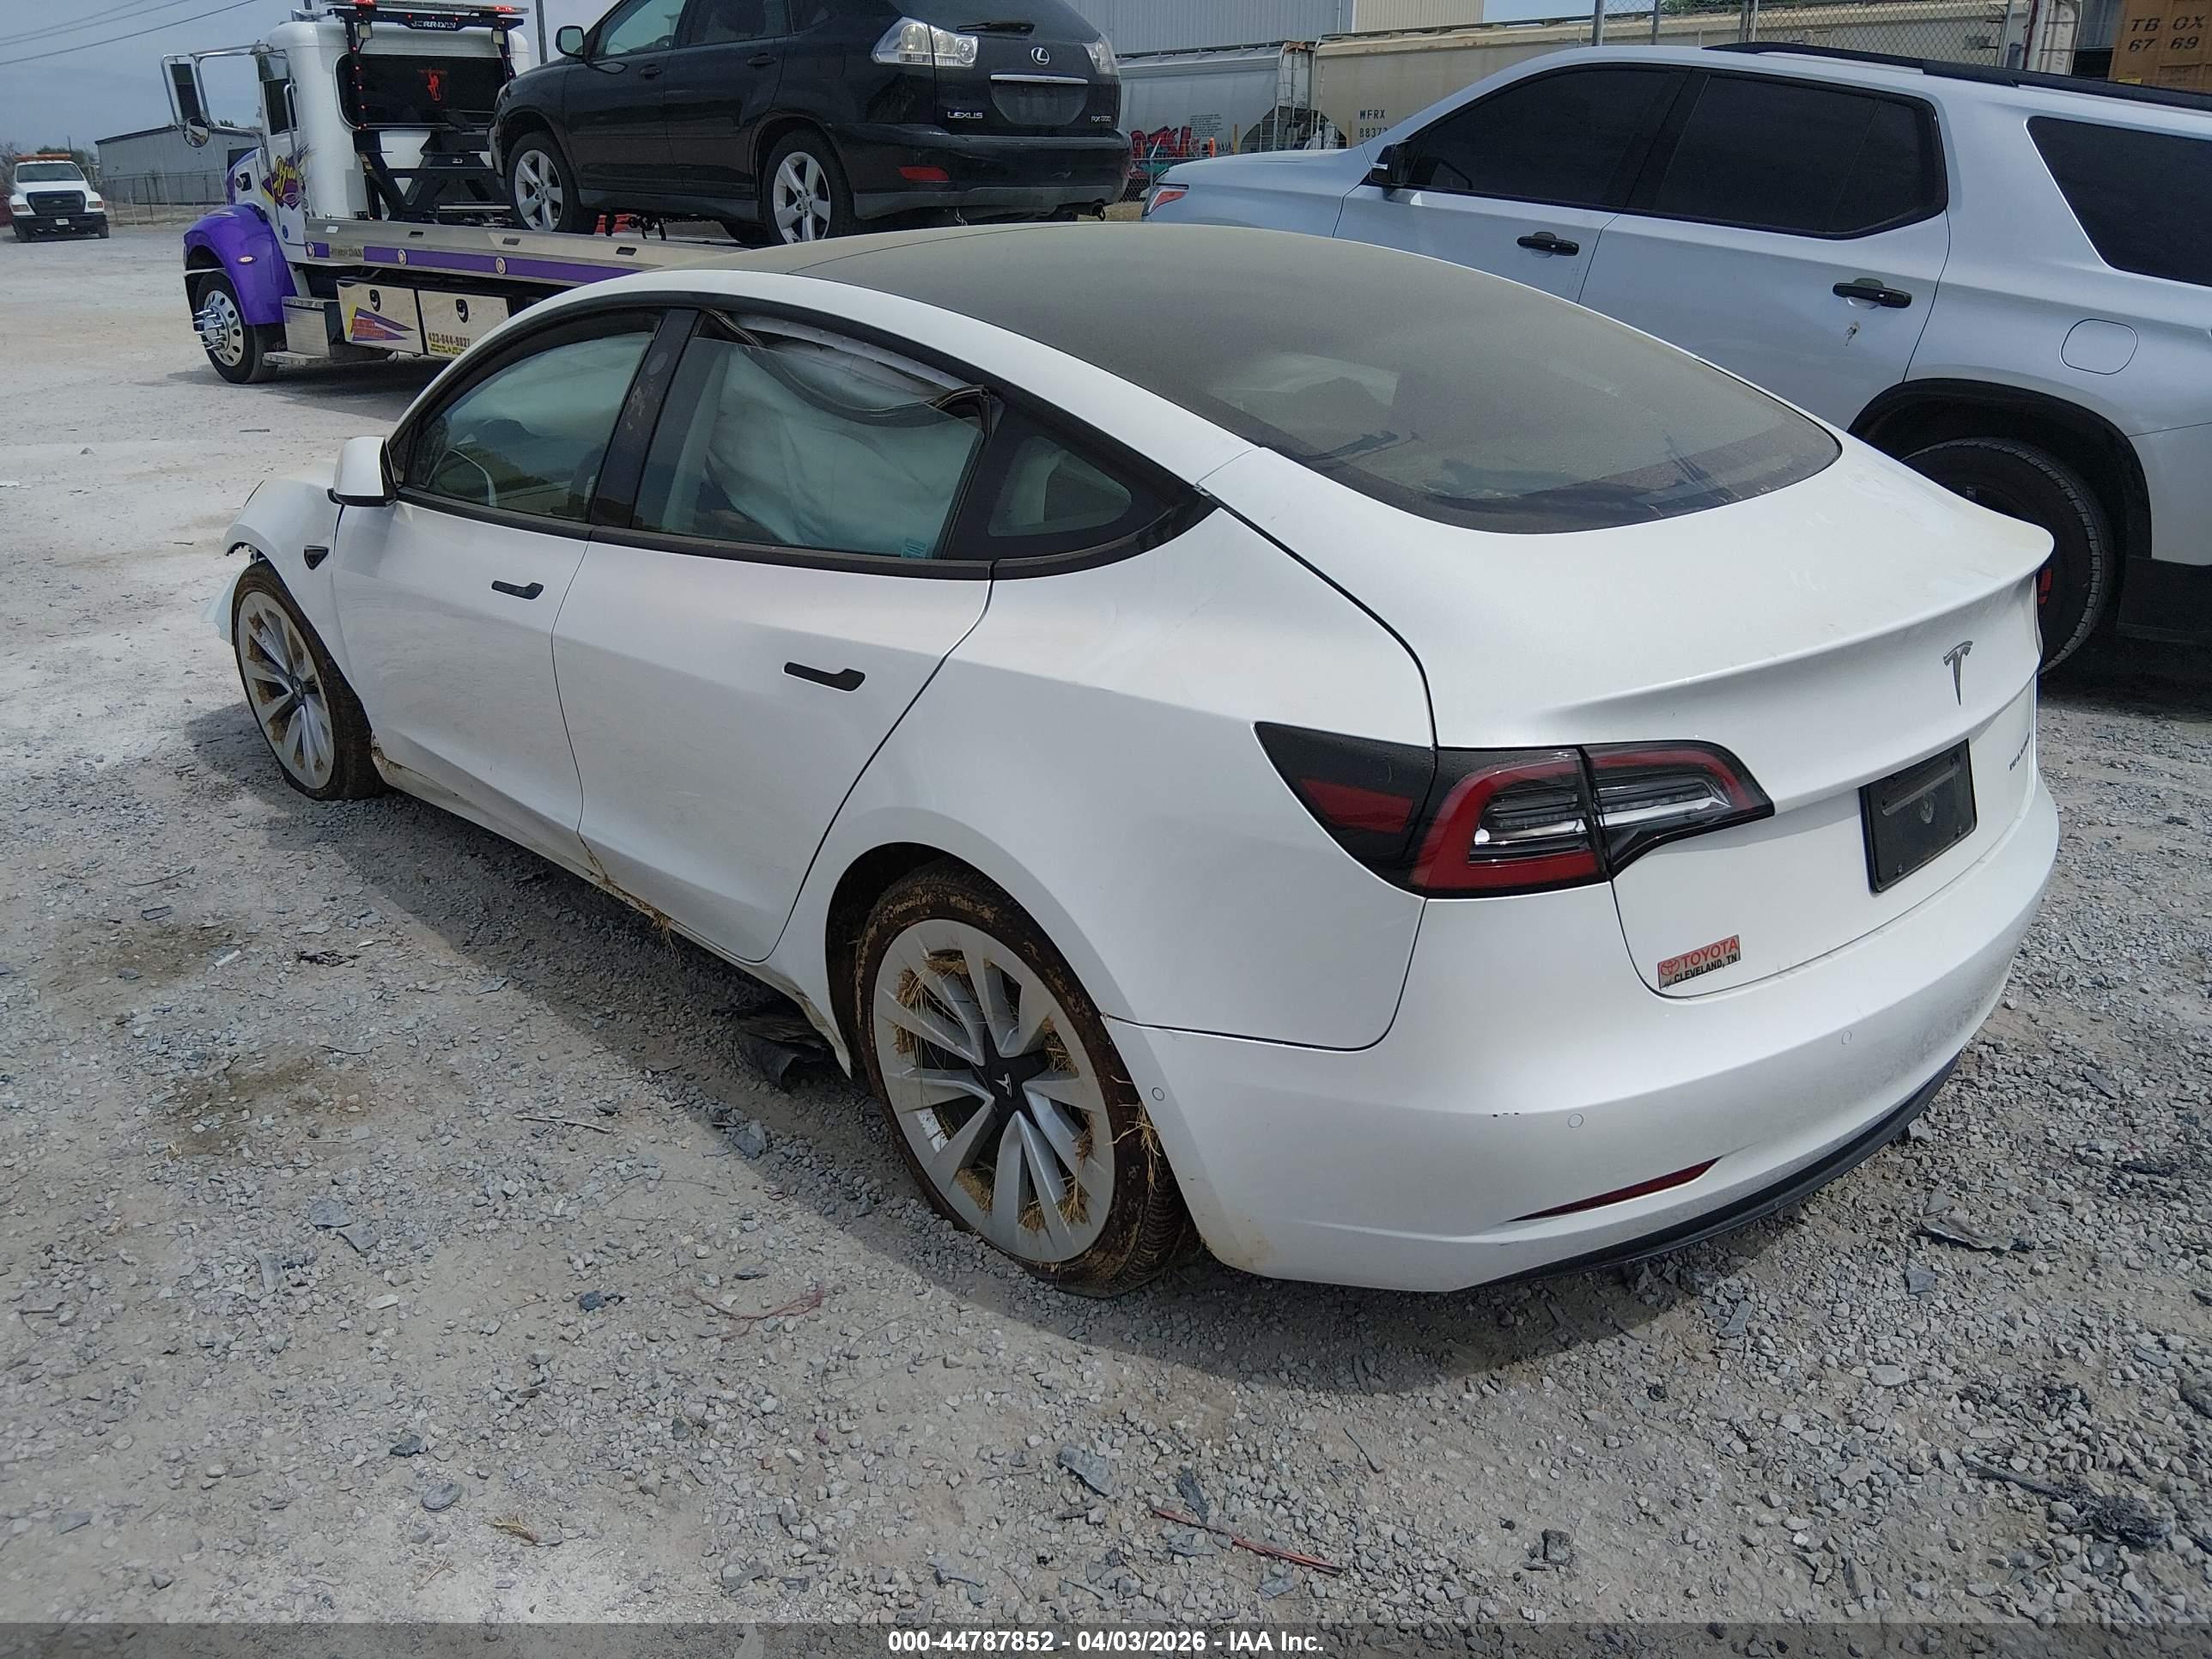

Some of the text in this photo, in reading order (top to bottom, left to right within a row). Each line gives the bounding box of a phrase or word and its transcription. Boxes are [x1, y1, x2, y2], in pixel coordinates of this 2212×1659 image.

[947, 111, 983, 119] LEXUS
[1359, 109, 1386, 120] WFRX
[1680, 938, 1739, 968] TOYOTA
[1674, 952, 1738, 984] CLEVELAND, TN
